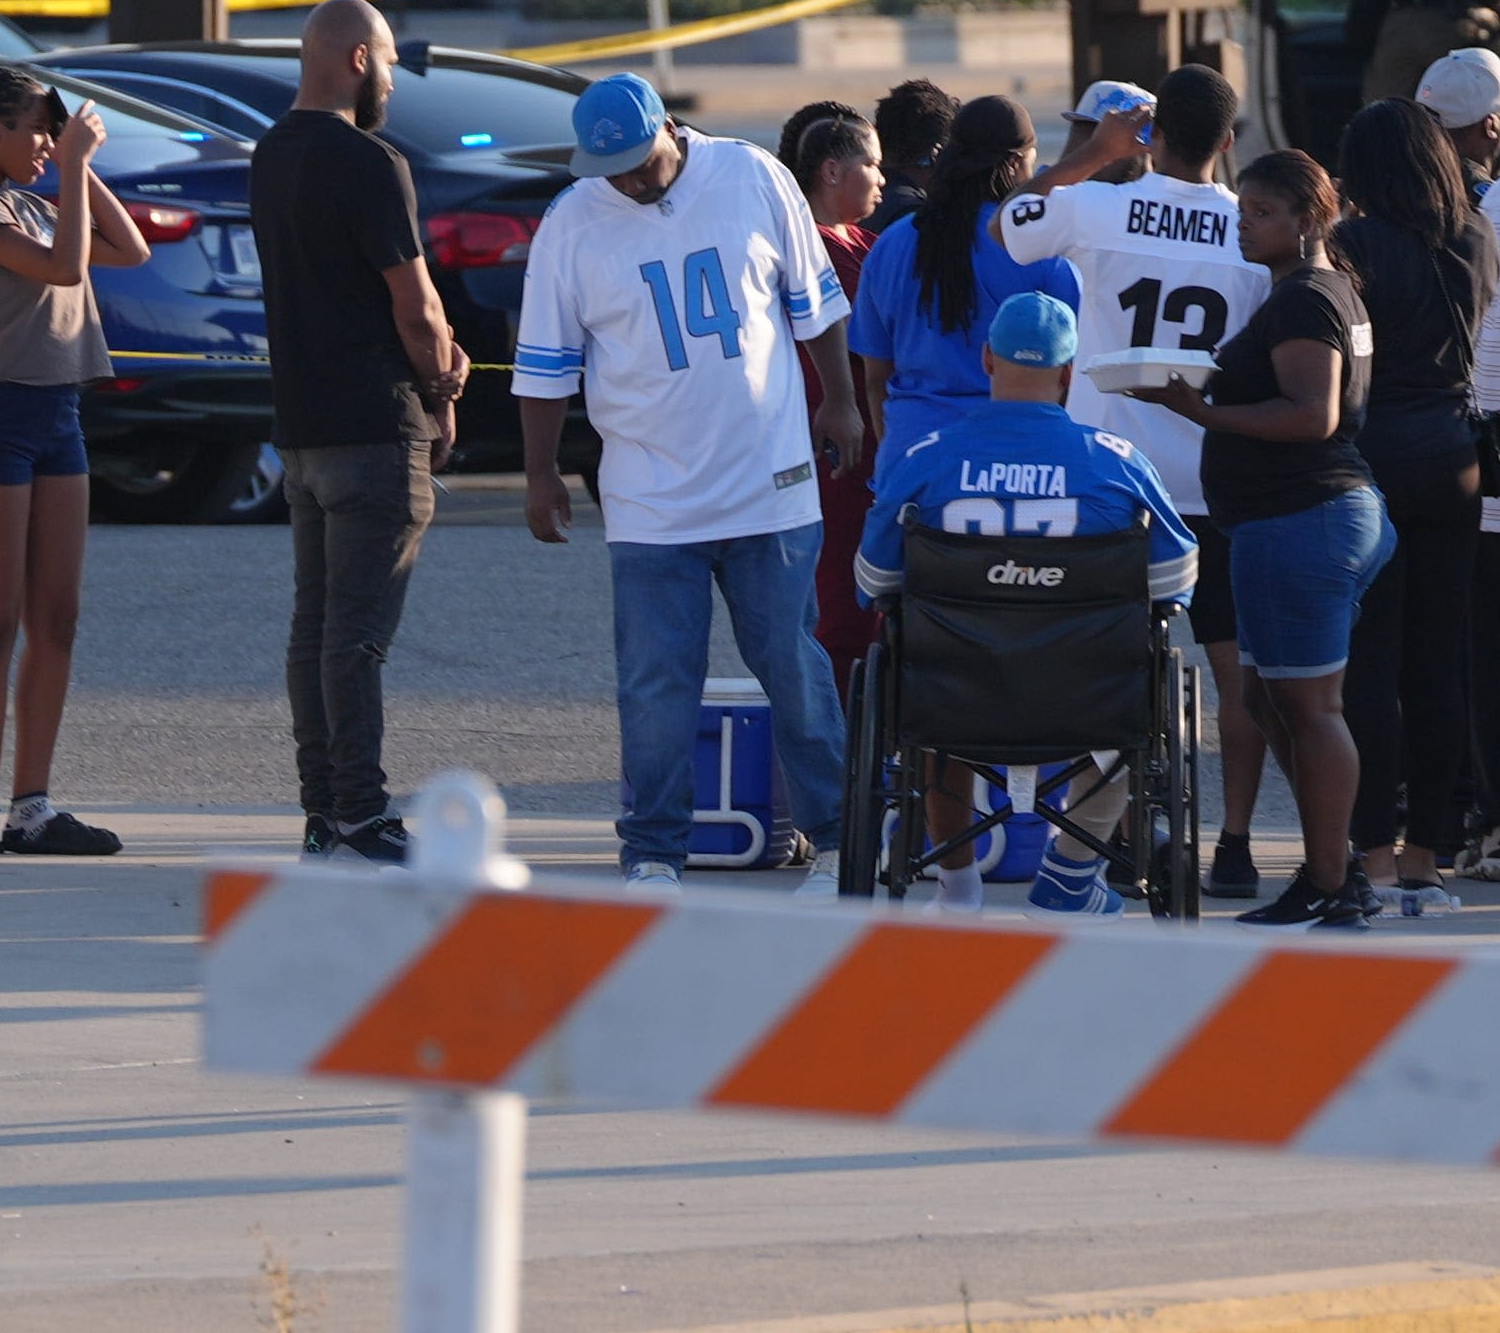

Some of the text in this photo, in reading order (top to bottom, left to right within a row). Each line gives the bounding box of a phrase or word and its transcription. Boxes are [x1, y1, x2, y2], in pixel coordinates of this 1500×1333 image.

[1127, 199, 1228, 247] BEAMEN
[638, 247, 742, 371] 14
[987, 559, 1065, 587] drive
